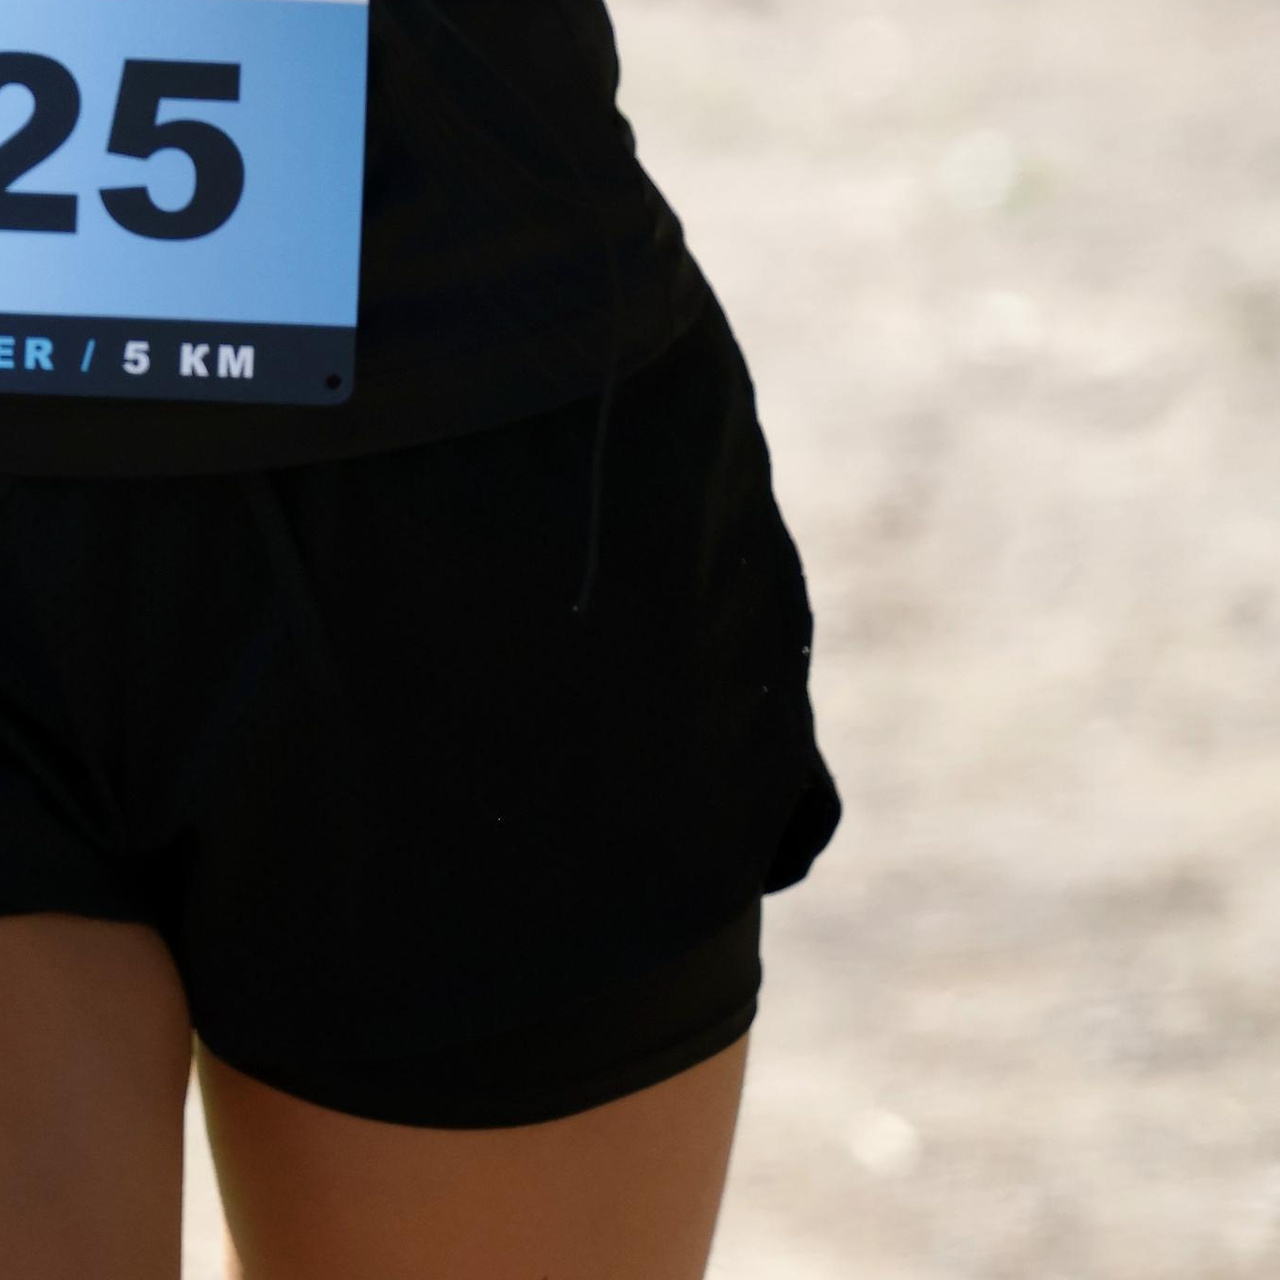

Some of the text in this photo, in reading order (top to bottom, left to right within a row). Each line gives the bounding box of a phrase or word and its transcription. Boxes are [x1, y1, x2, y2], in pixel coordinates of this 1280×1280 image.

[80, 338, 96, 373] /
[122, 340, 150, 375] 5
[179, 343, 255, 379] KM
